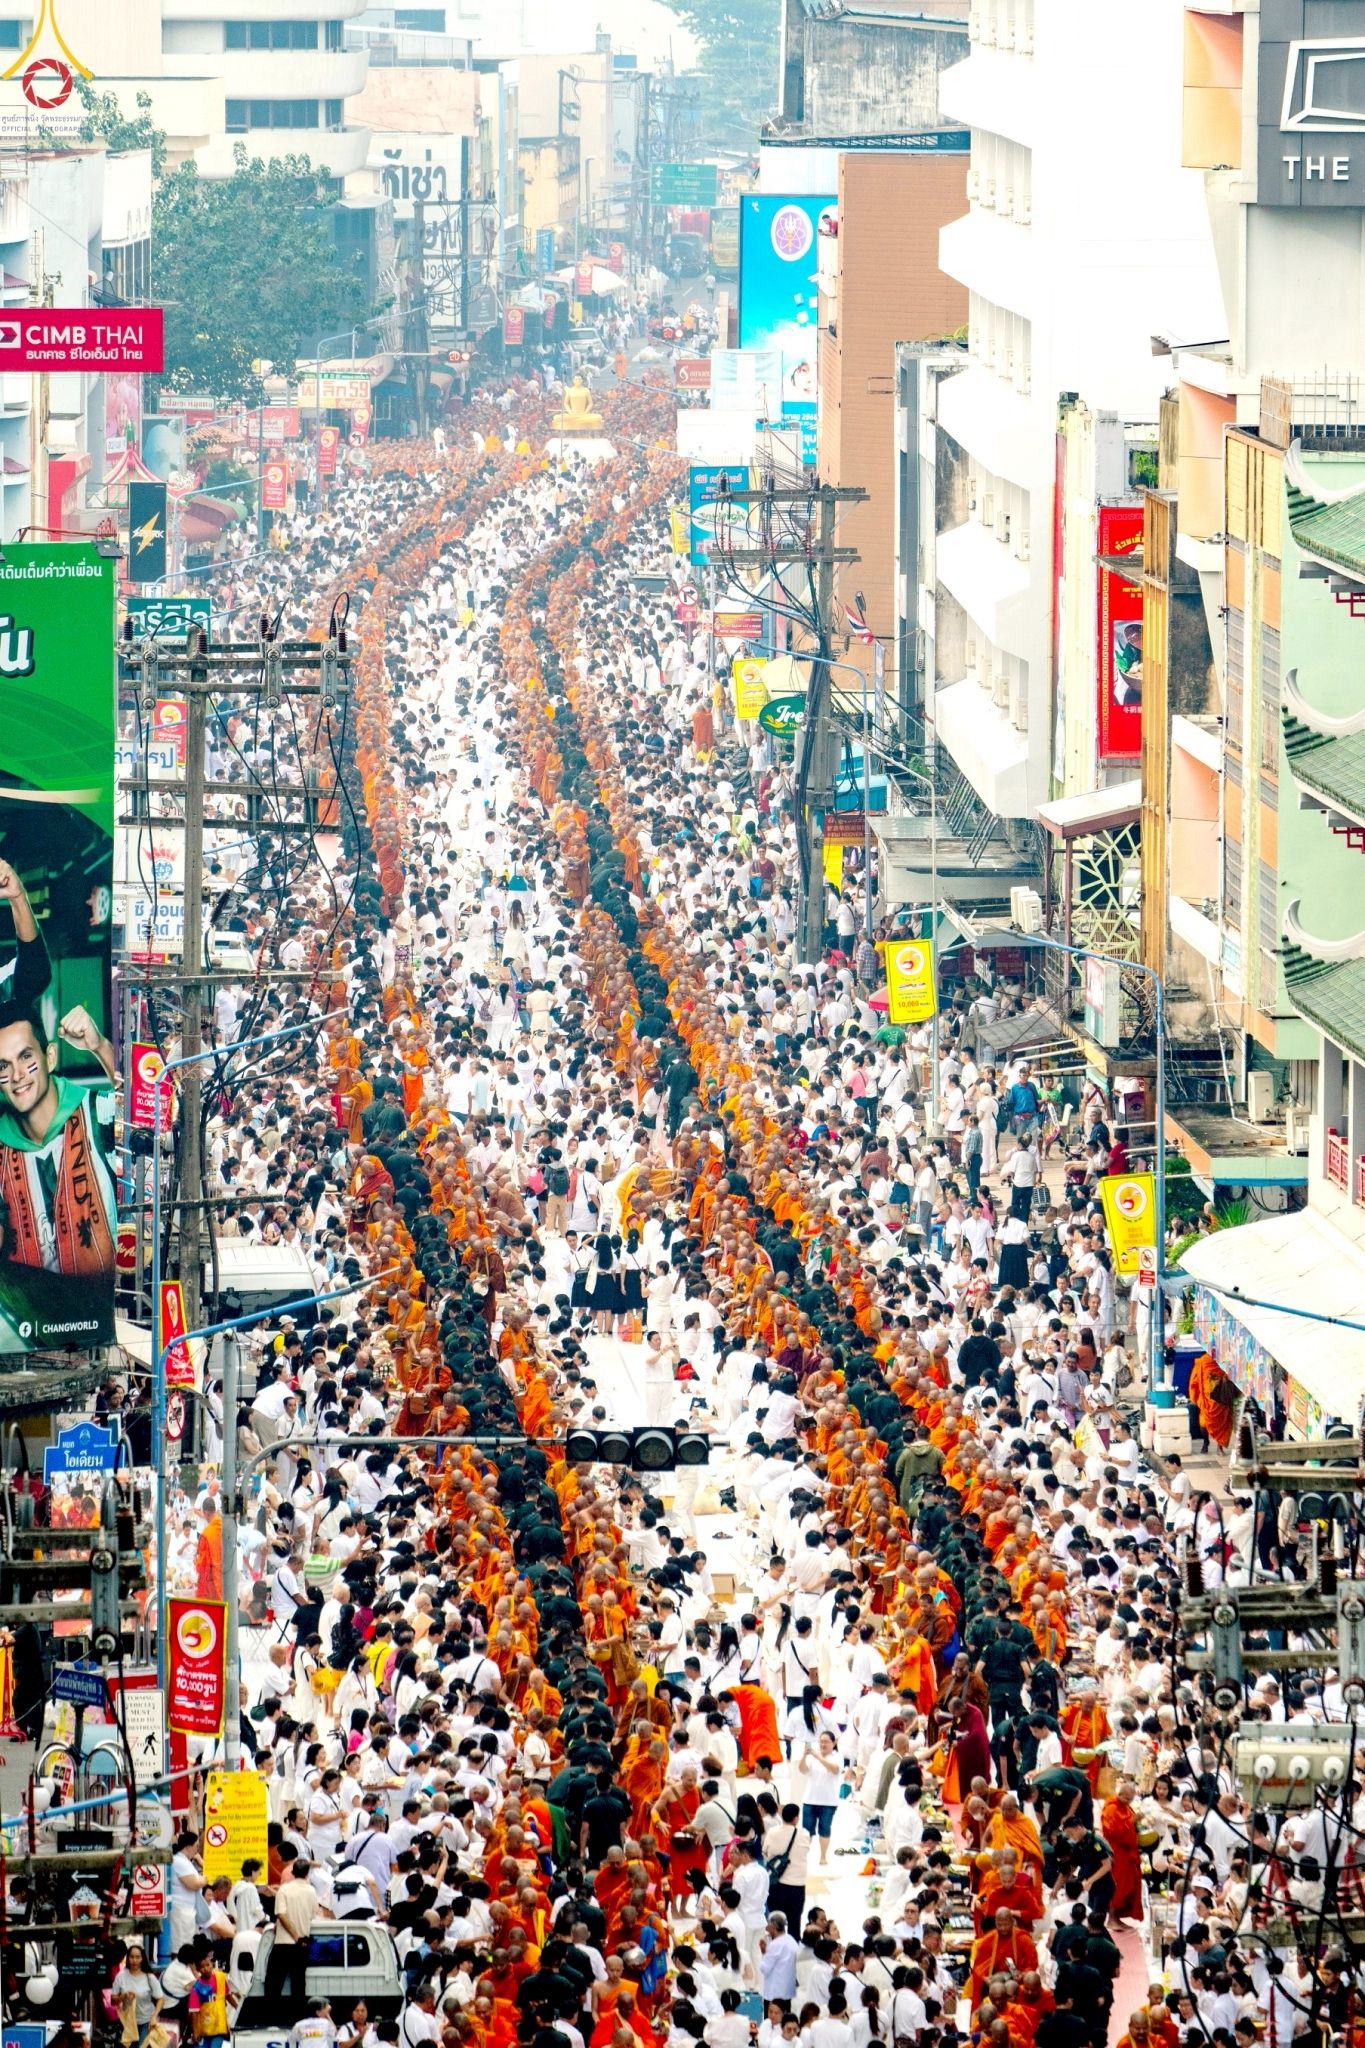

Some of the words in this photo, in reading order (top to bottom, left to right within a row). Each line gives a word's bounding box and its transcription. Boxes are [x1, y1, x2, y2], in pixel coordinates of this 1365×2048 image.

[1282, 155, 1350, 181] THE
[25, 325, 87, 345] CIMB
[91, 326, 143, 345] THAI
[26, 349, 66, 360] ธนาคาร
[121, 346, 144, 360] ไทย
[42, 1320, 99, 1334] CHANGWORLD
[64, 1449, 104, 1468] โอเดียน
